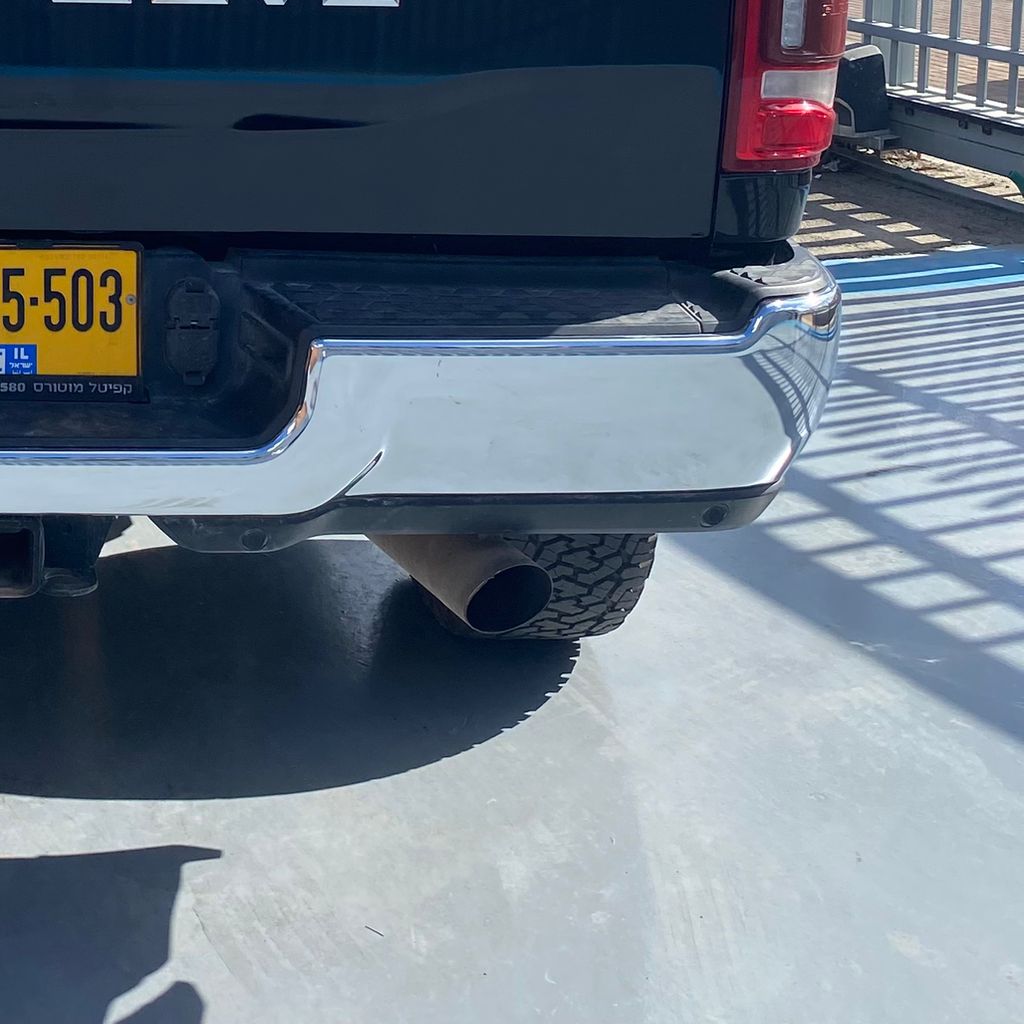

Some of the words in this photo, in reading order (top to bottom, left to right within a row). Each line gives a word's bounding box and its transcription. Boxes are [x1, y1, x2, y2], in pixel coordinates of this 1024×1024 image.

[14, 347, 29, 360] IL
[33, 382, 84, 394] מוטורס
[88, 381, 133, 395] קפיטל
